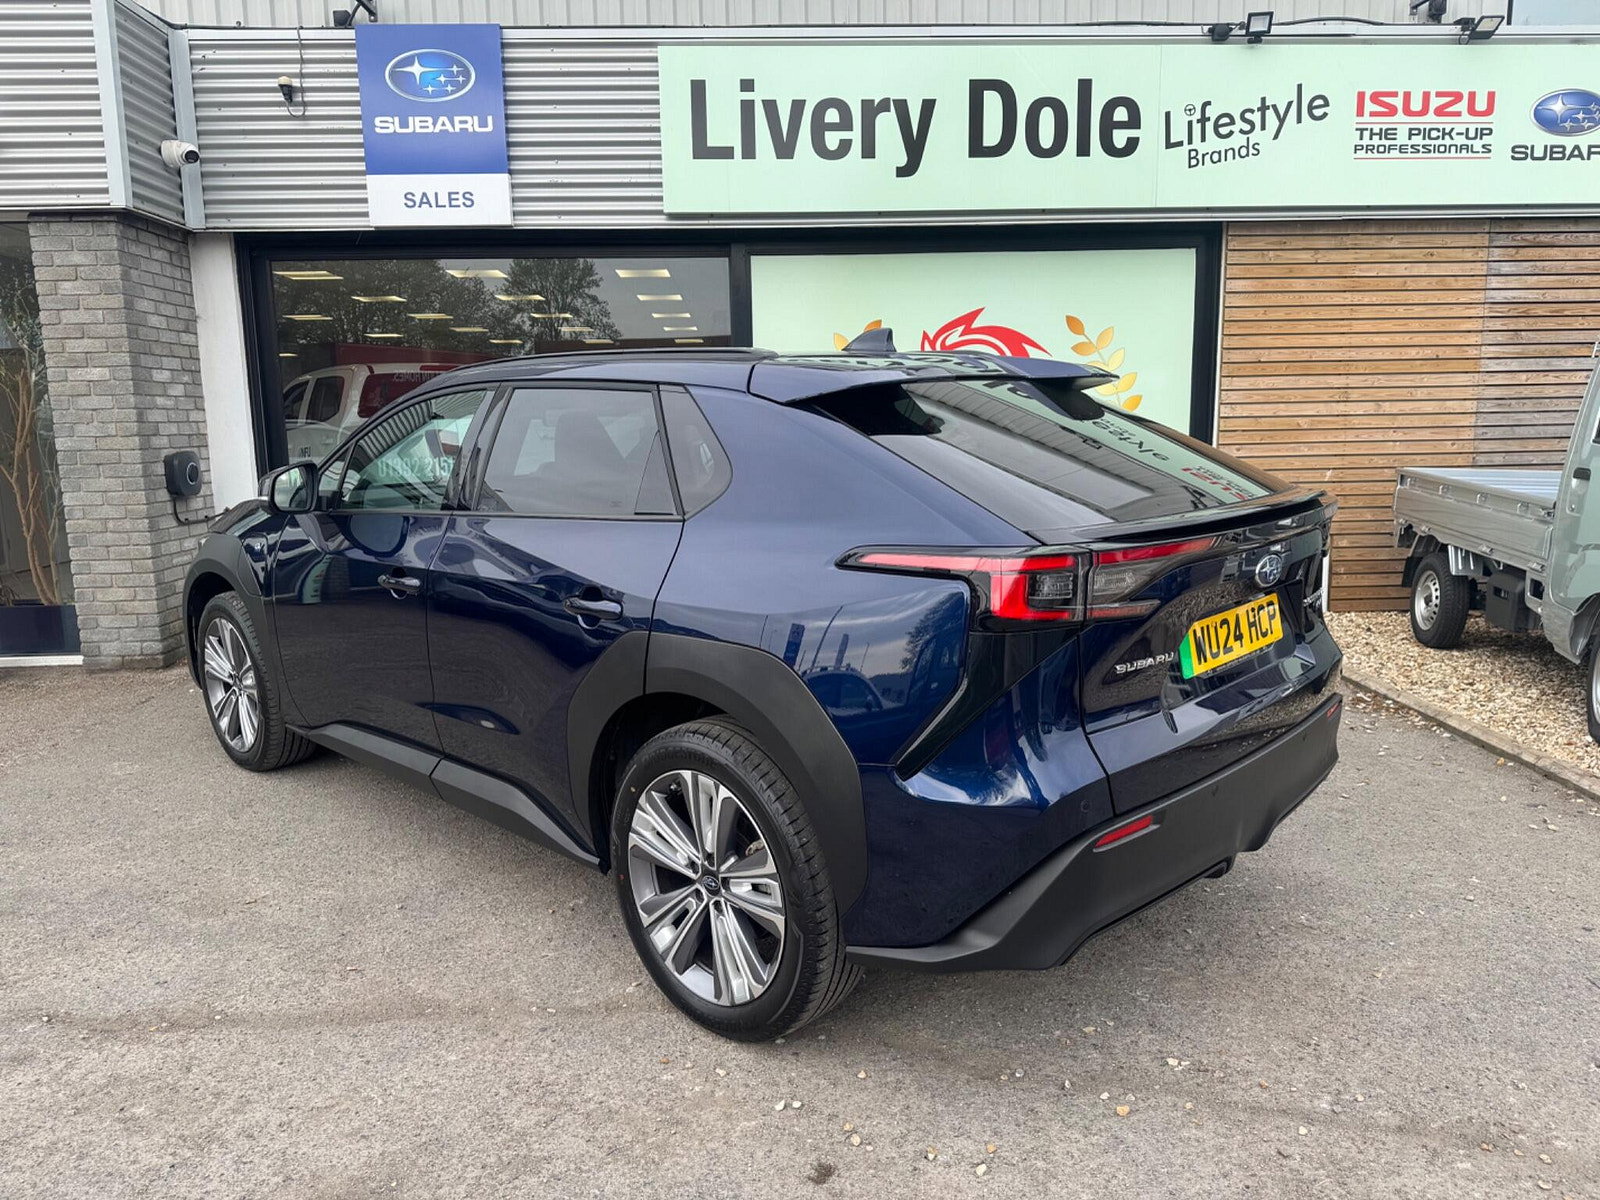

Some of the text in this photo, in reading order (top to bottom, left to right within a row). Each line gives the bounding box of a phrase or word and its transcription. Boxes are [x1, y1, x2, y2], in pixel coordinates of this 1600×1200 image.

[1355, 90, 1496, 118] ISUZU
[374, 115, 493, 134] SUBARU
[690, 78, 1142, 178] Livery Dole
[1164, 83, 1330, 150] Lifestyle
[1355, 127, 1494, 141] THE PICK-UP
[1188, 136, 1261, 169] Brands
[1353, 143, 1492, 155] PROFESSIONALS
[1510, 144, 1600, 161] SUBAR
[403, 191, 475, 209] SALES
[1193, 617, 1244, 666] WU24
[1246, 600, 1277, 645] HCP
[1114, 651, 1174, 674] SUBARU
